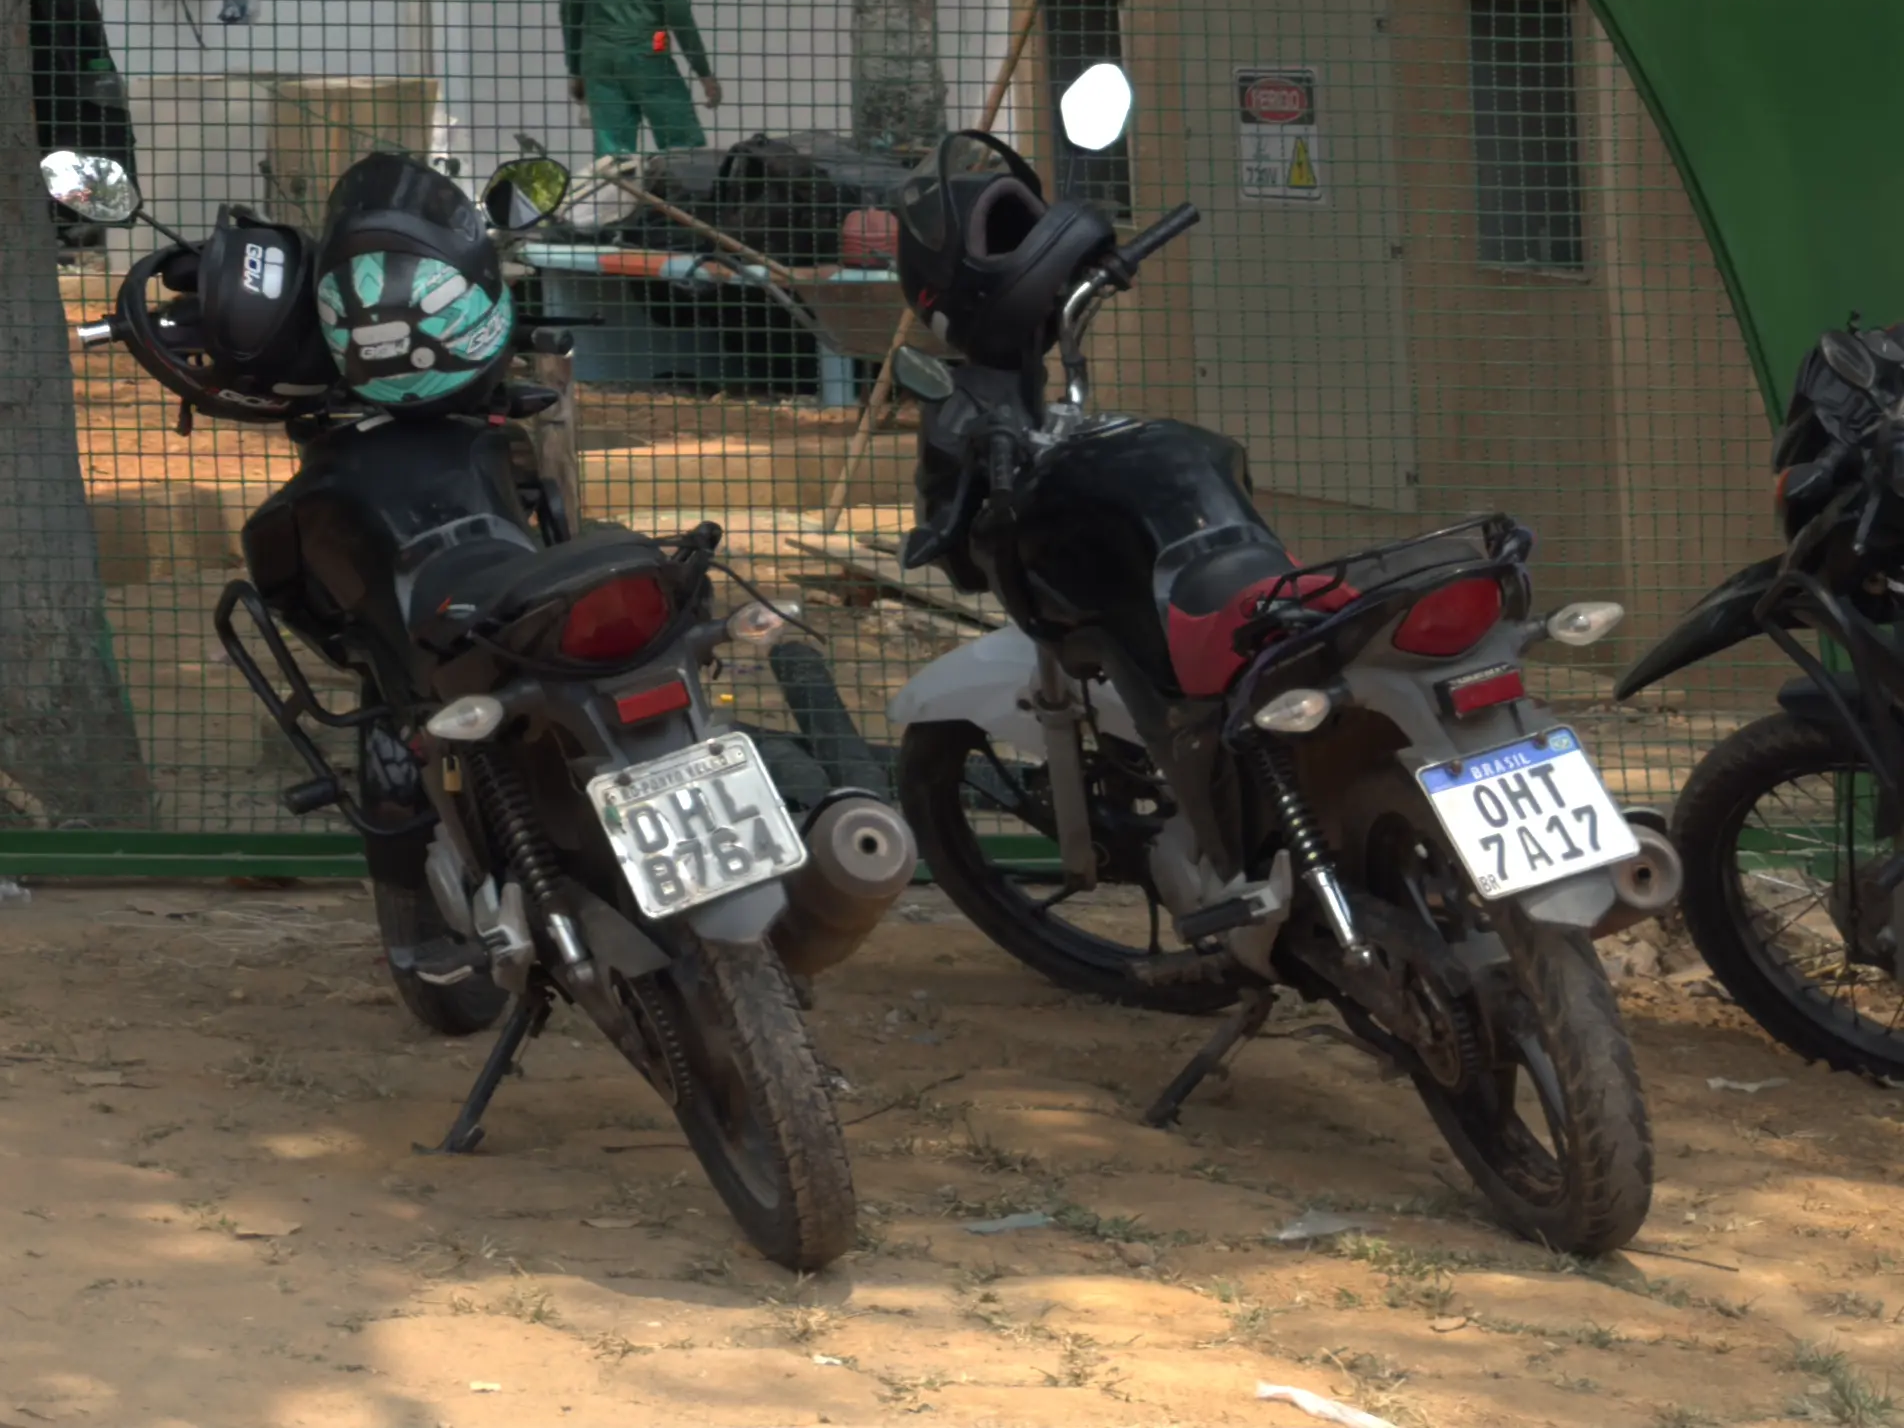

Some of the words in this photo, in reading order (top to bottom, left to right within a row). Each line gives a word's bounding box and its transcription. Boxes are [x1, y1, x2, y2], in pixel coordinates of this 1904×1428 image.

[1470, 752, 1531, 780] BRASIL
[1473, 763, 1566, 828] OHT
[626, 779, 760, 854] OHL
[1478, 804, 1601, 881] 7A17
[642, 817, 786, 906] 8764
[1478, 874, 1501, 894] BR
